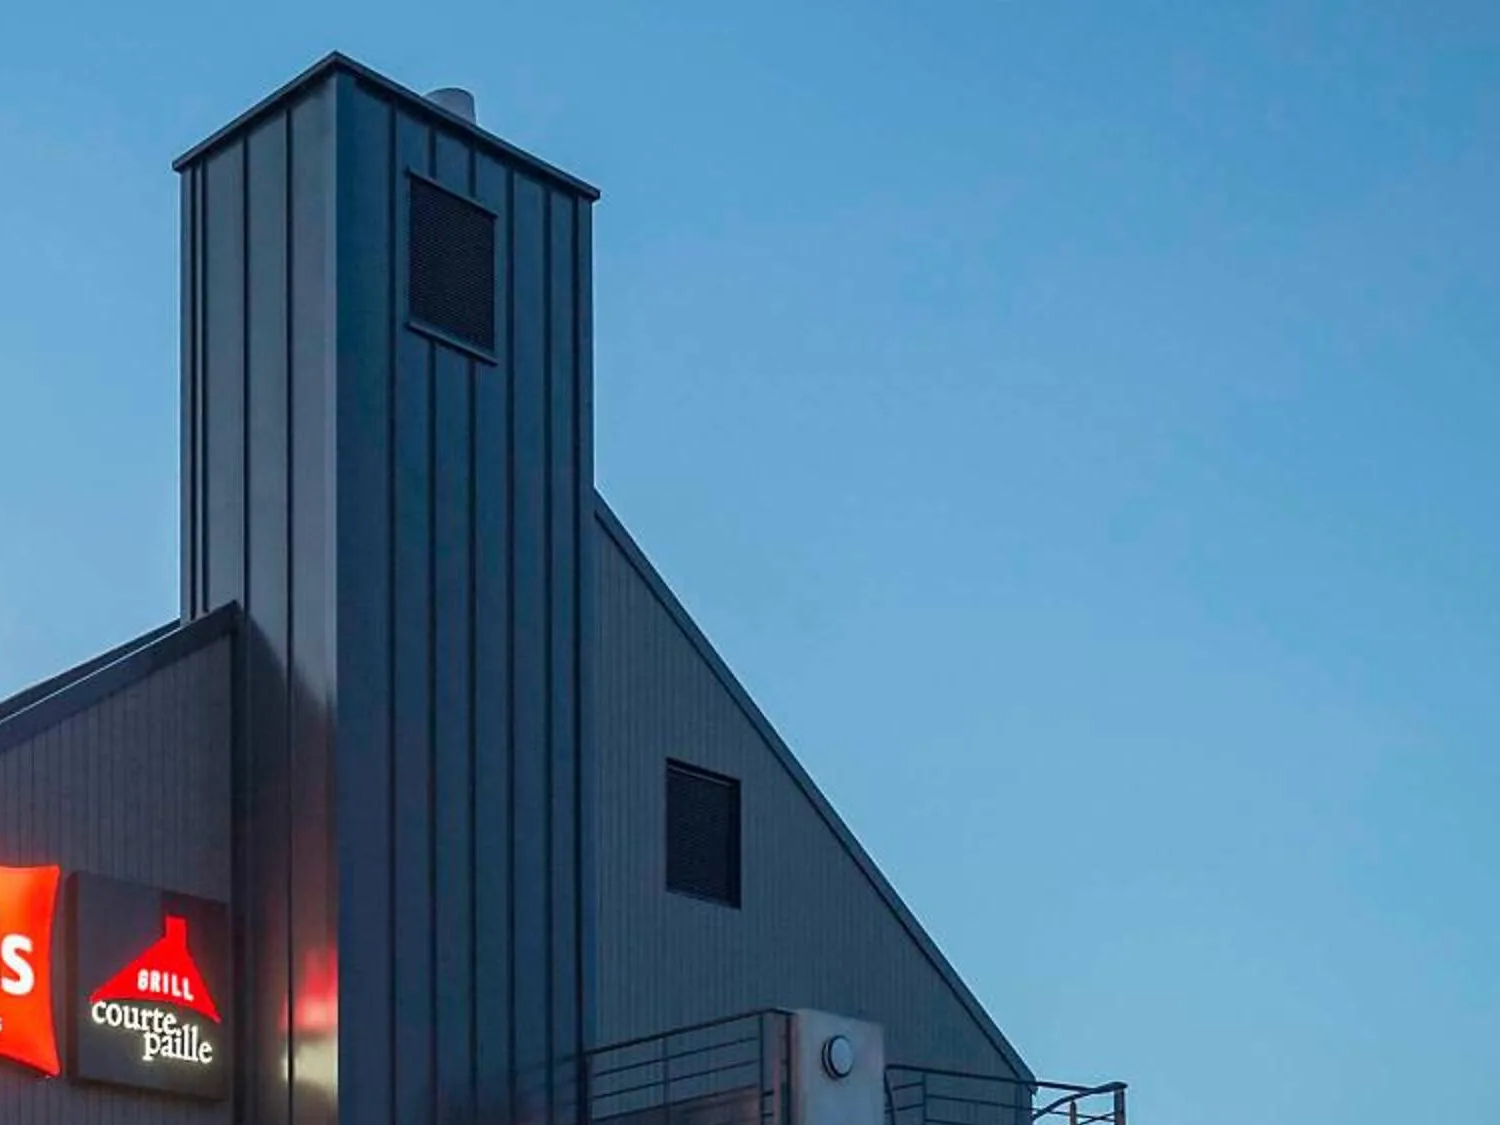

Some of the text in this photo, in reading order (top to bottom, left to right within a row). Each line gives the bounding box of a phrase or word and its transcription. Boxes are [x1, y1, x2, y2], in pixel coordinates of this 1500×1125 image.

[137, 968, 194, 1002] GRILL
[91, 1000, 178, 1035] courte
[142, 1023, 213, 1064] paille
